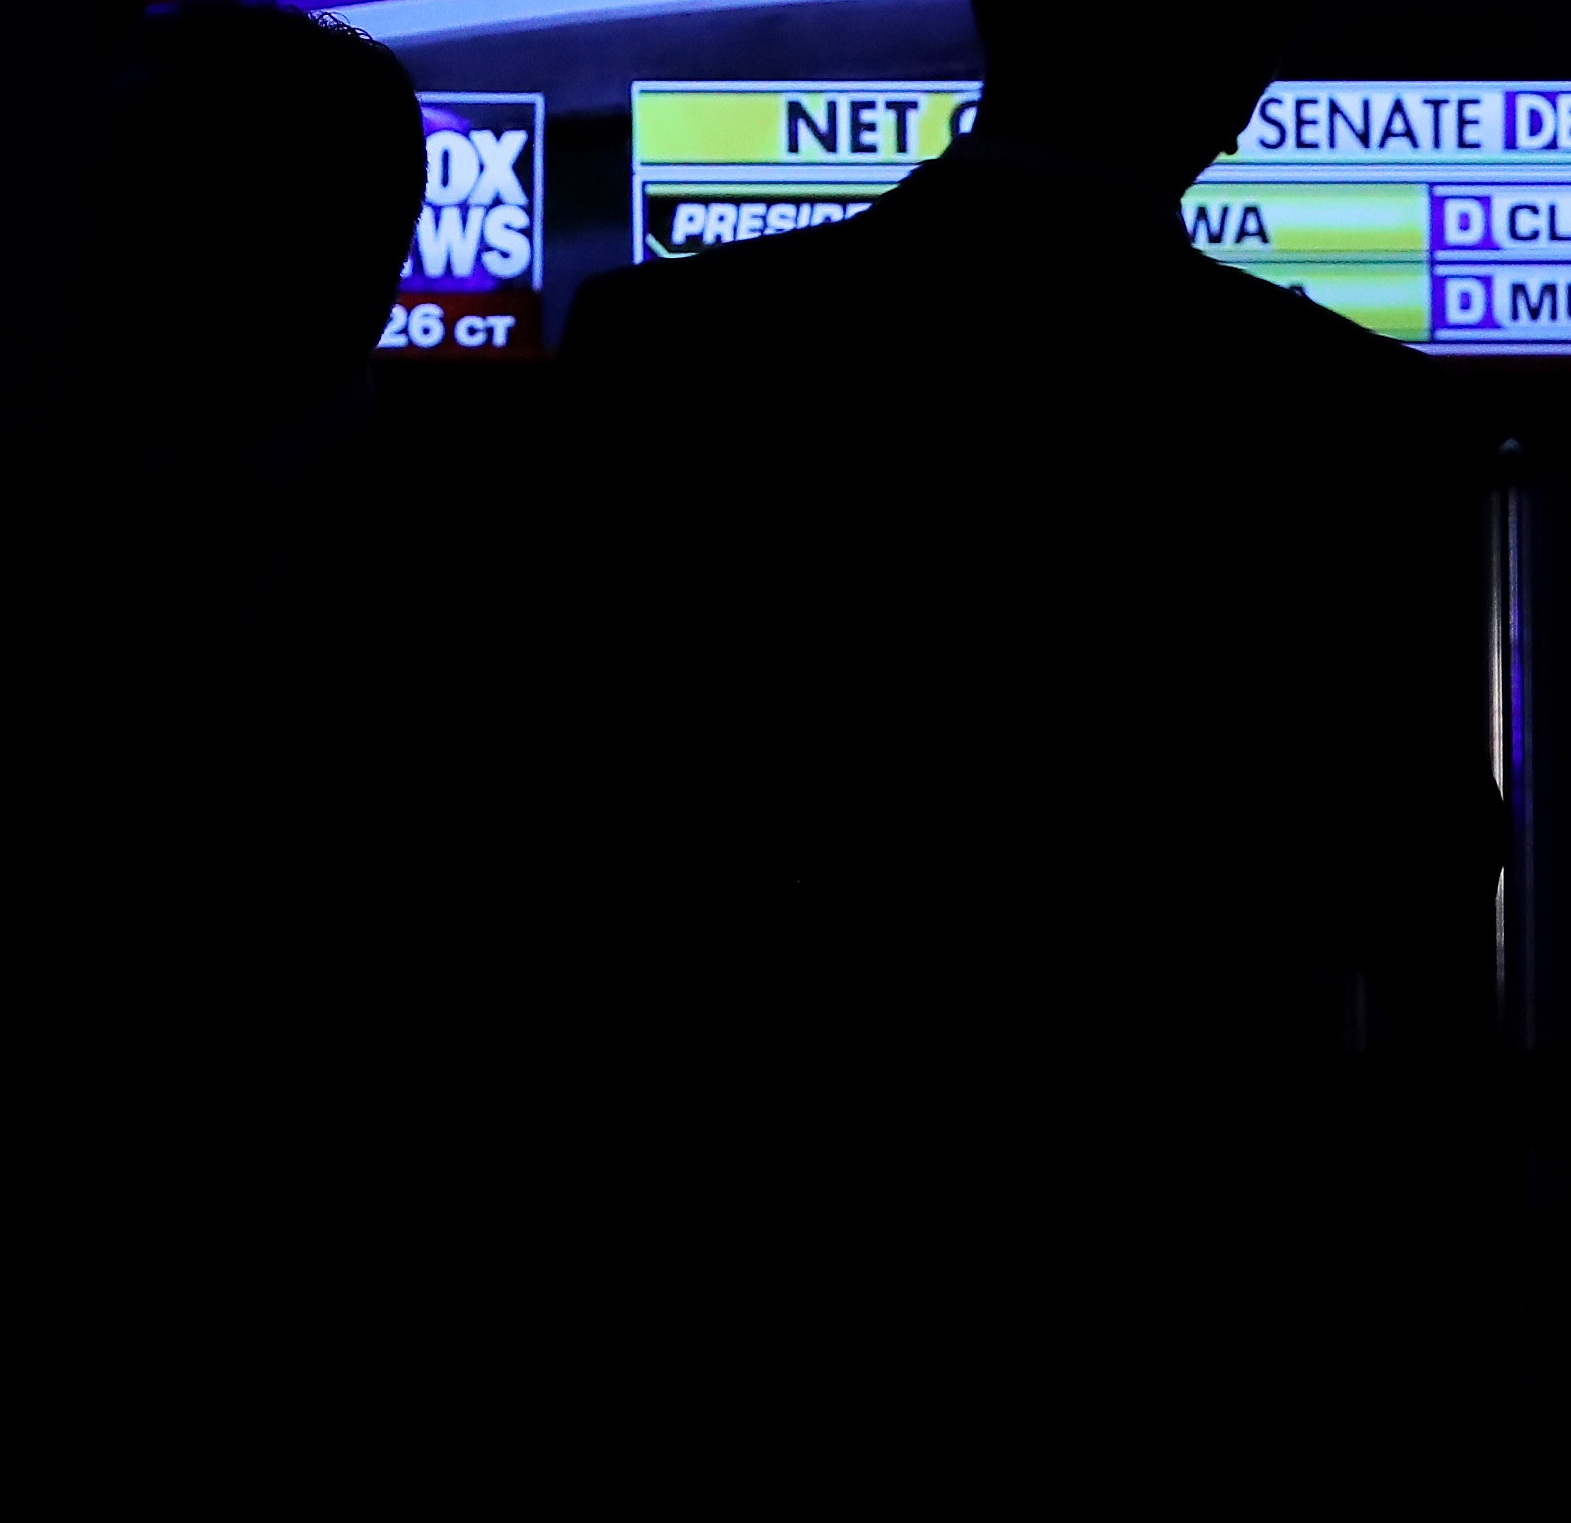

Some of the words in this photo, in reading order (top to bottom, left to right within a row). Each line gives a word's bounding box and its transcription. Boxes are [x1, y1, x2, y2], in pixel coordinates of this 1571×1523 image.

[787, 99, 919, 154] NET
[1258, 97, 1482, 150] SENATE
[426, 129, 528, 206] OX
[401, 204, 531, 278] WS
[1184, 205, 1271, 244] WA
[1443, 198, 1486, 246] D
[377, 303, 445, 348] 26
[454, 315, 517, 348] CT
[1443, 278, 1486, 326] D
